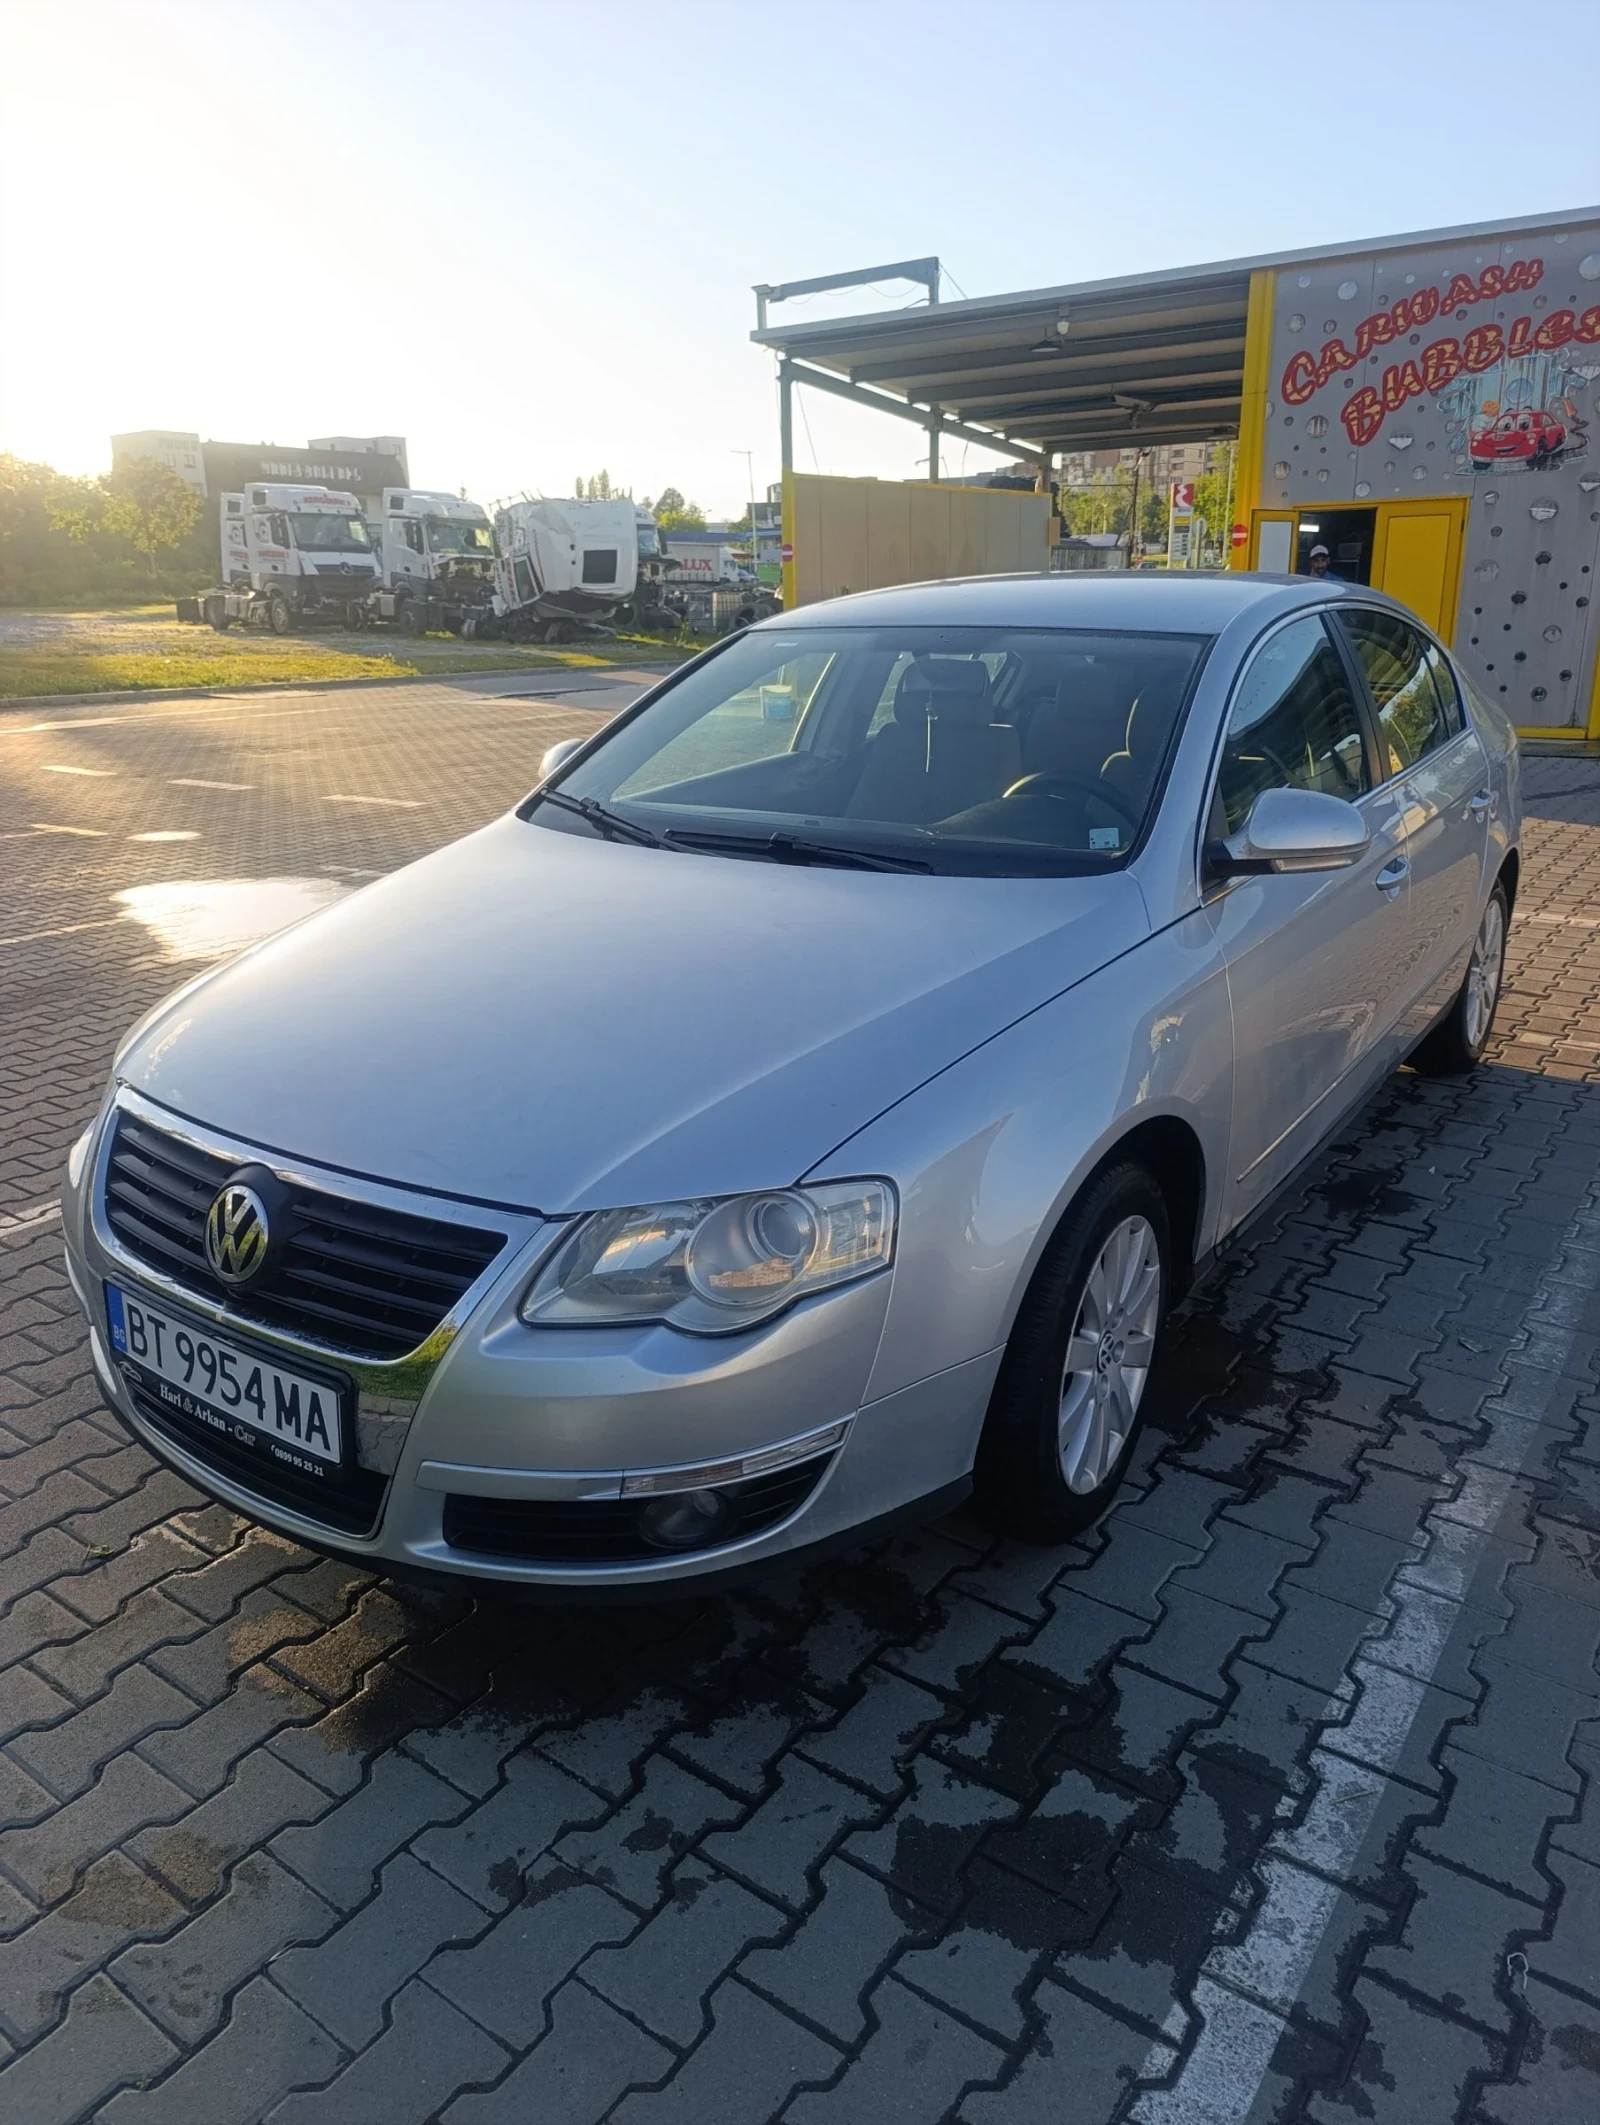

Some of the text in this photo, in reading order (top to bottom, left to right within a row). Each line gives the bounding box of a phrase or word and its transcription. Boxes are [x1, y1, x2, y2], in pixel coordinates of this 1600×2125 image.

[680, 558, 713, 571] LUX
[113, 1324, 126, 1344] BG
[126, 1301, 332, 1452] BT 9954 MA
[159, 1384, 182, 1408] Hari
[183, 1396, 194, 1414] &
[194, 1404, 226, 1432] Arkan
[234, 1425, 257, 1447] Car
[275, 1447, 293, 1463] 0899
